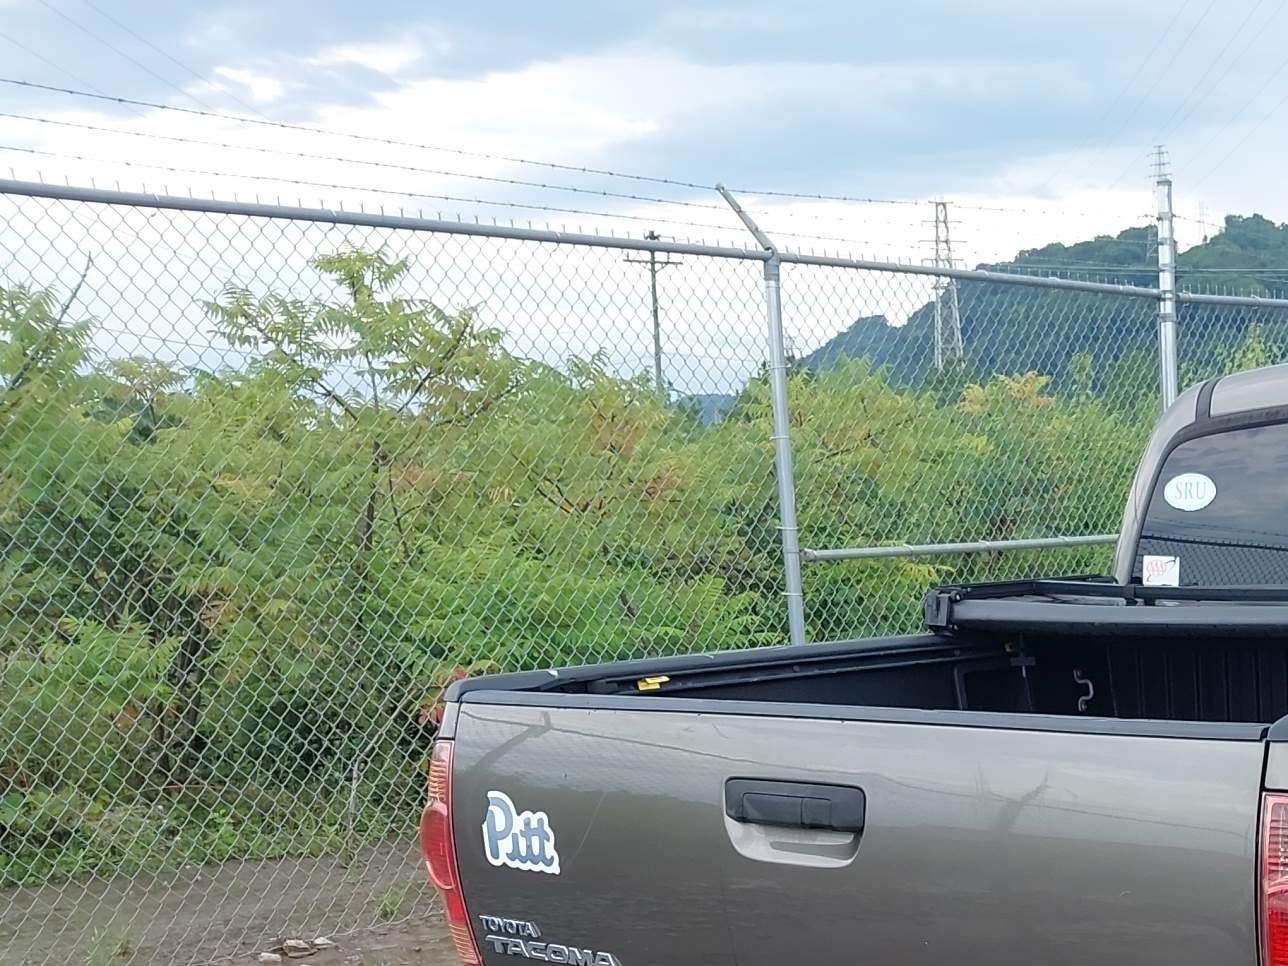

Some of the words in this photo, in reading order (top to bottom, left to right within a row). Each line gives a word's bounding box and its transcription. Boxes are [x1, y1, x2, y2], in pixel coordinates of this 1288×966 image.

[1174, 480, 1207, 501] SRU
[486, 796, 555, 867] Pitt
[479, 915, 541, 938] TOYOTA
